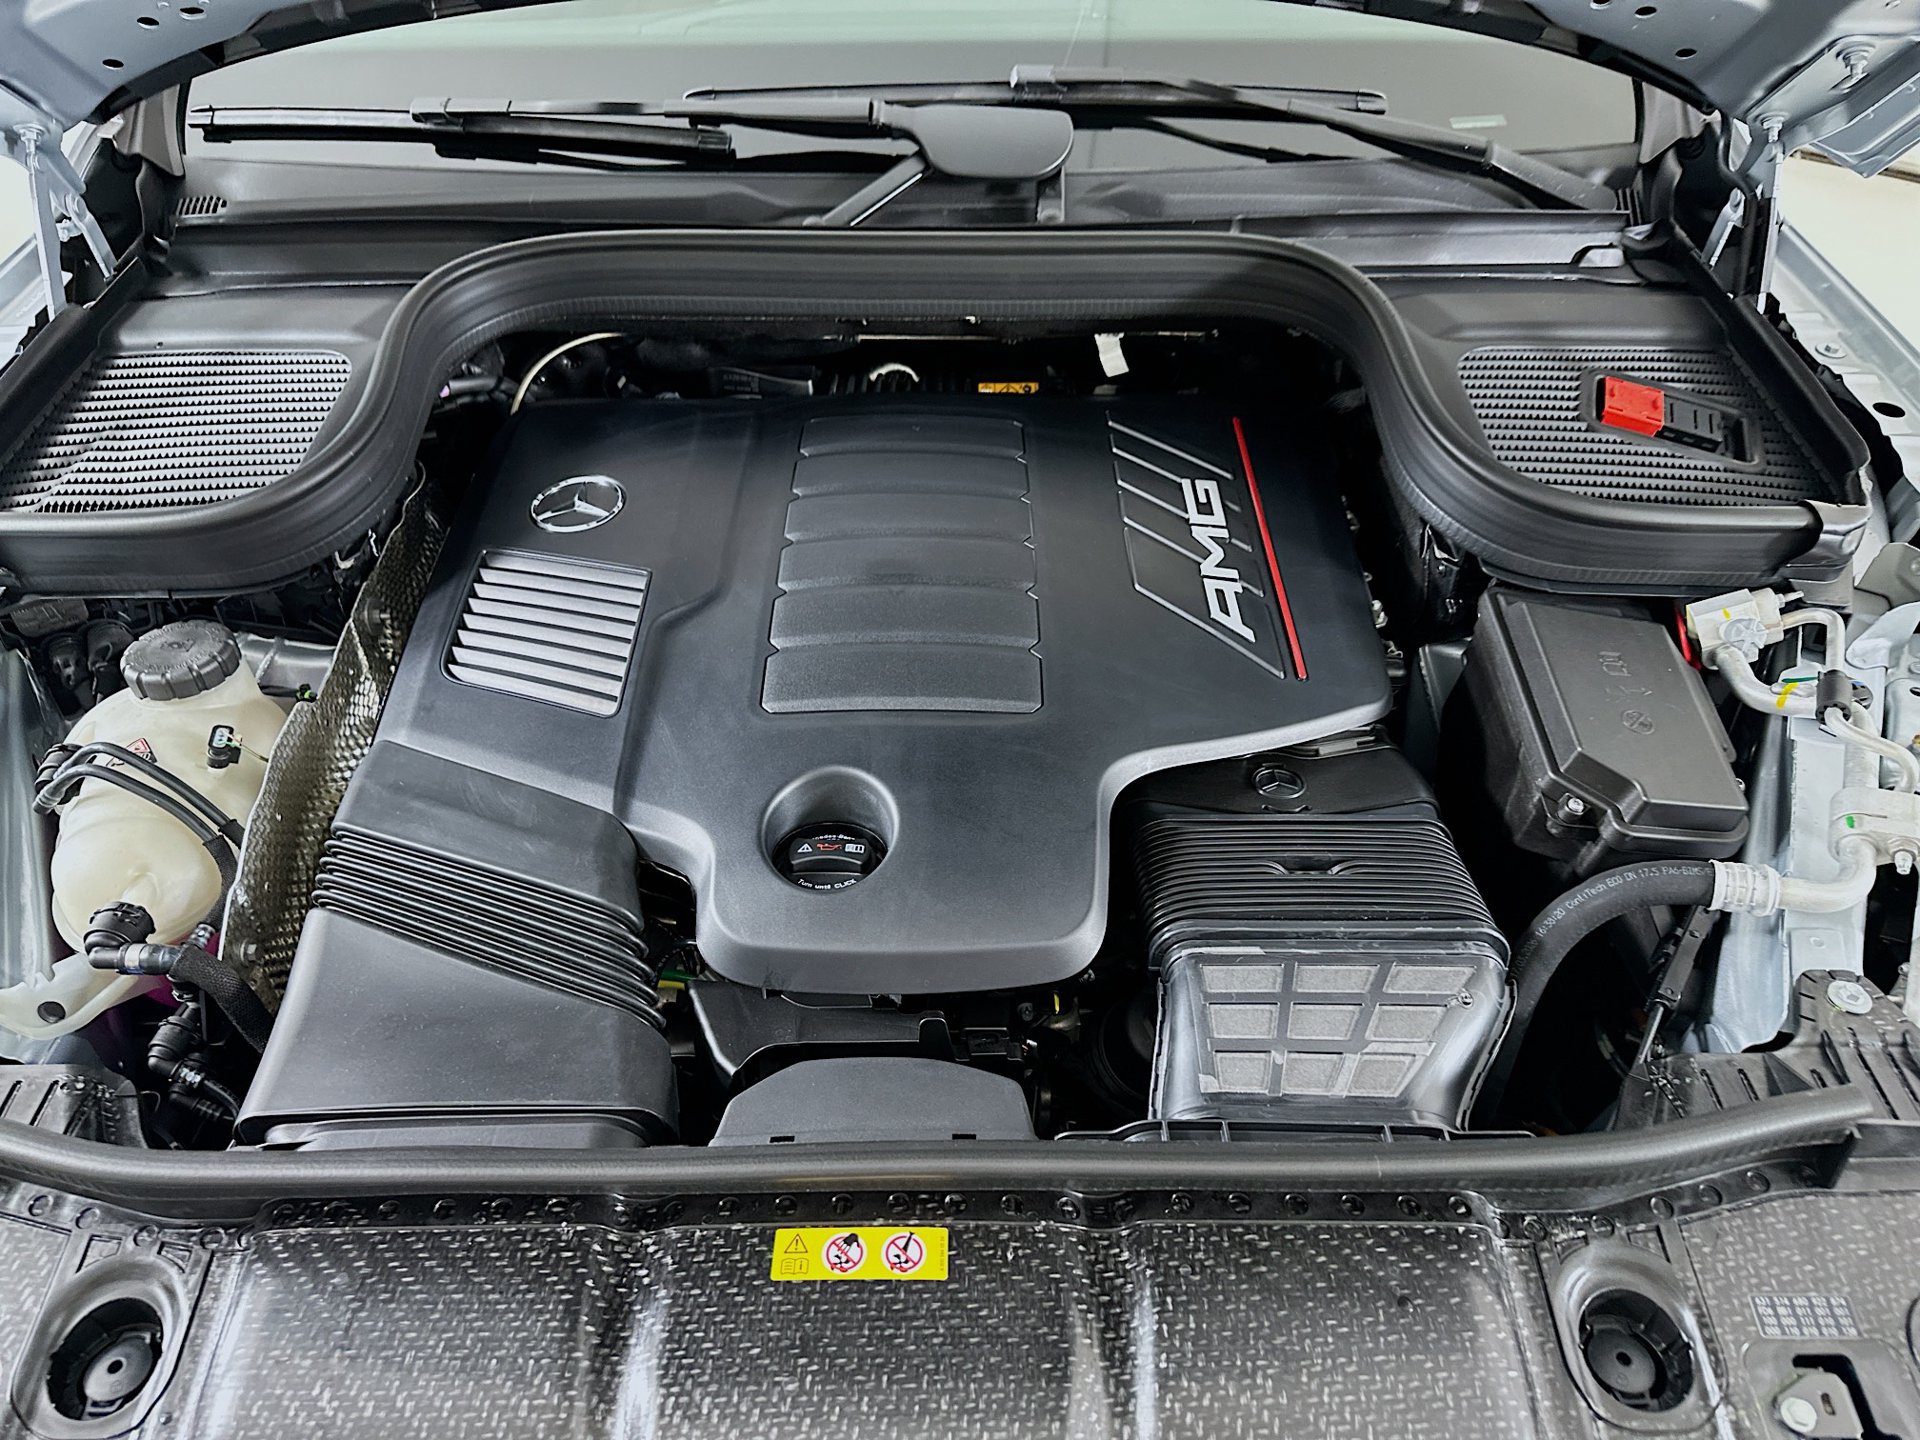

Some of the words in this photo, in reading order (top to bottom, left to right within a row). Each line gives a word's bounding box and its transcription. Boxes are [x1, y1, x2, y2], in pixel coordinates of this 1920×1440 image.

[1181, 478, 1256, 643] AMG
[797, 879, 812, 888] Turn
[834, 879, 857, 889] CLICK
[1565, 882, 1607, 909] ContiTech
